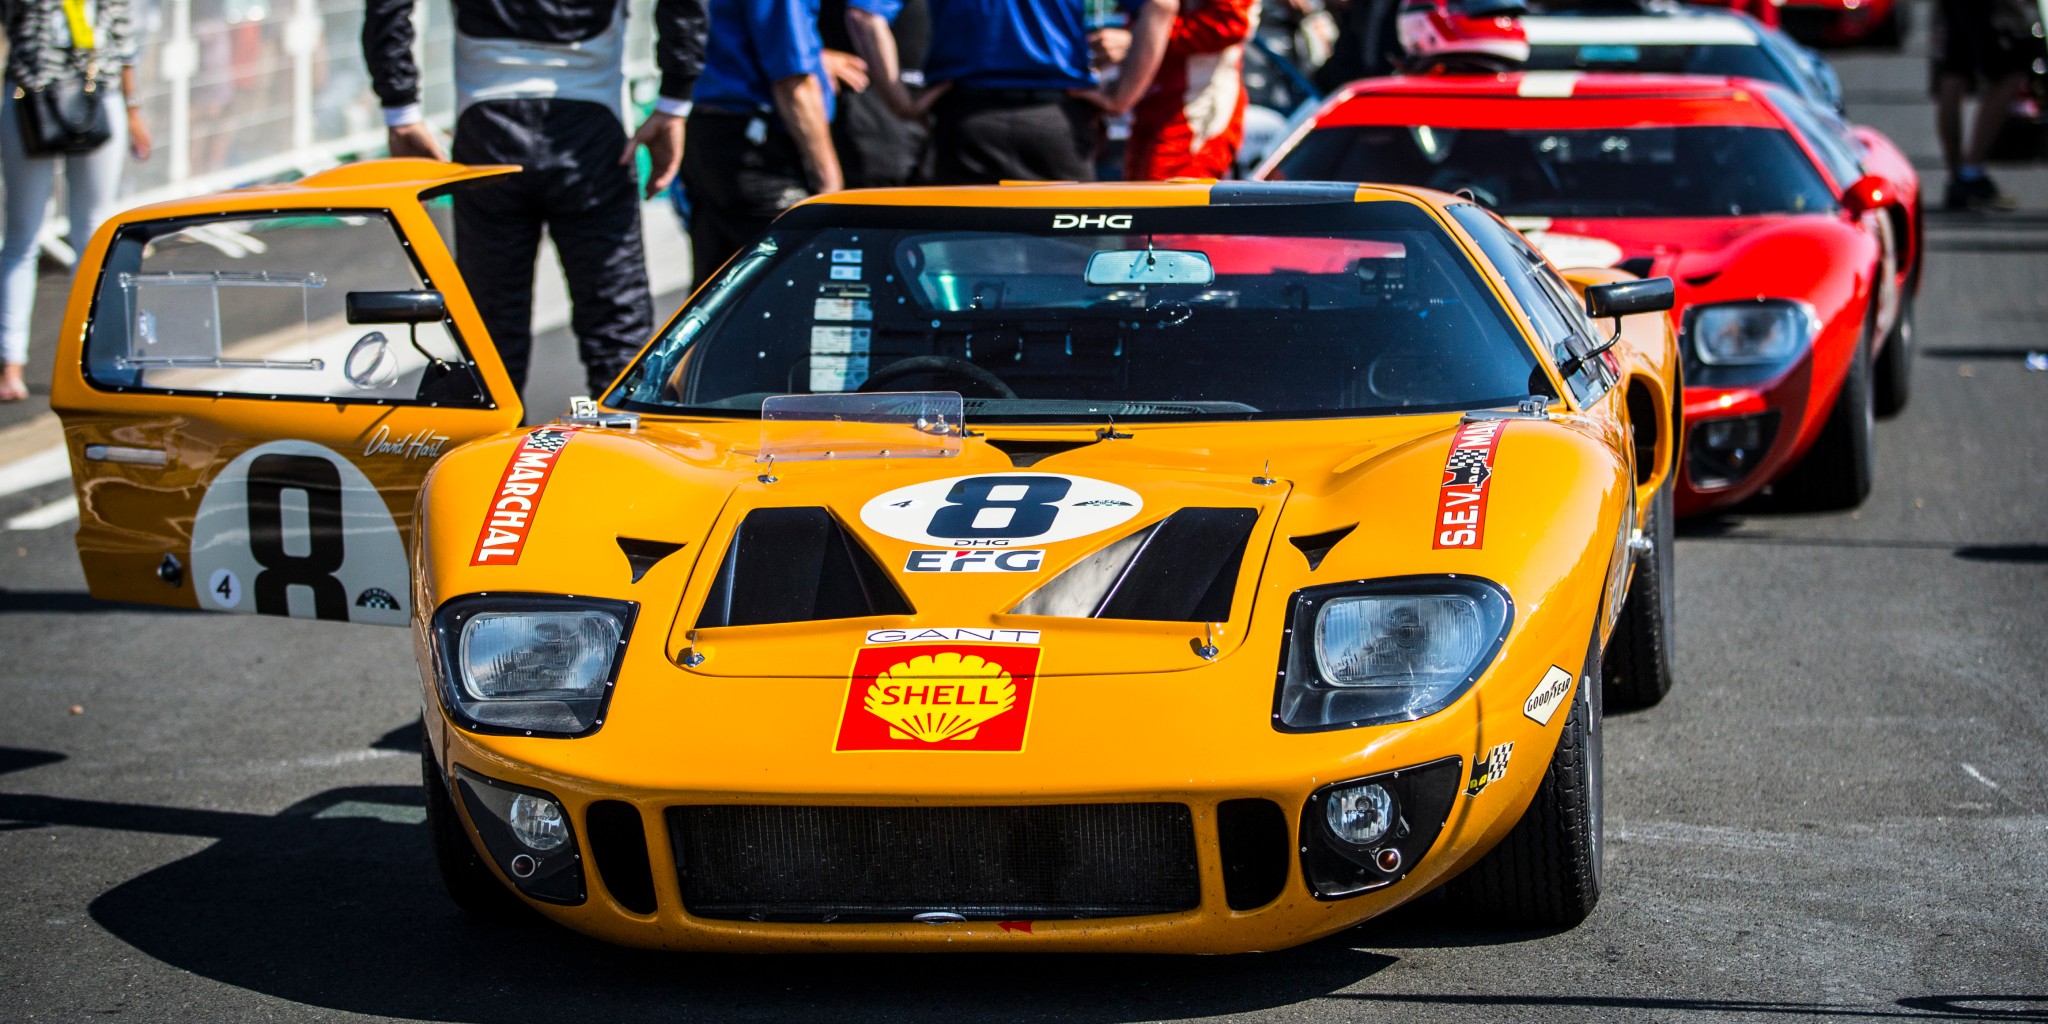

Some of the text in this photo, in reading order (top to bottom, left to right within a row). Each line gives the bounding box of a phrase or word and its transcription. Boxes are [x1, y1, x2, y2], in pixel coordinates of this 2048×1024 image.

[1052, 213, 1134, 230] DHG
[363, 424, 450, 460] David Hart
[477, 451, 554, 563] MARCHAL
[890, 499, 914, 509] 4
[926, 475, 1073, 539] 8
[1439, 487, 1482, 546] S.E.V.
[247, 453, 350, 622] 8
[954, 538, 1010, 547] DHG
[905, 550, 1041, 572] EFG
[215, 574, 232, 600] 4
[867, 628, 1040, 644] GANT
[881, 685, 999, 706] SHELL
